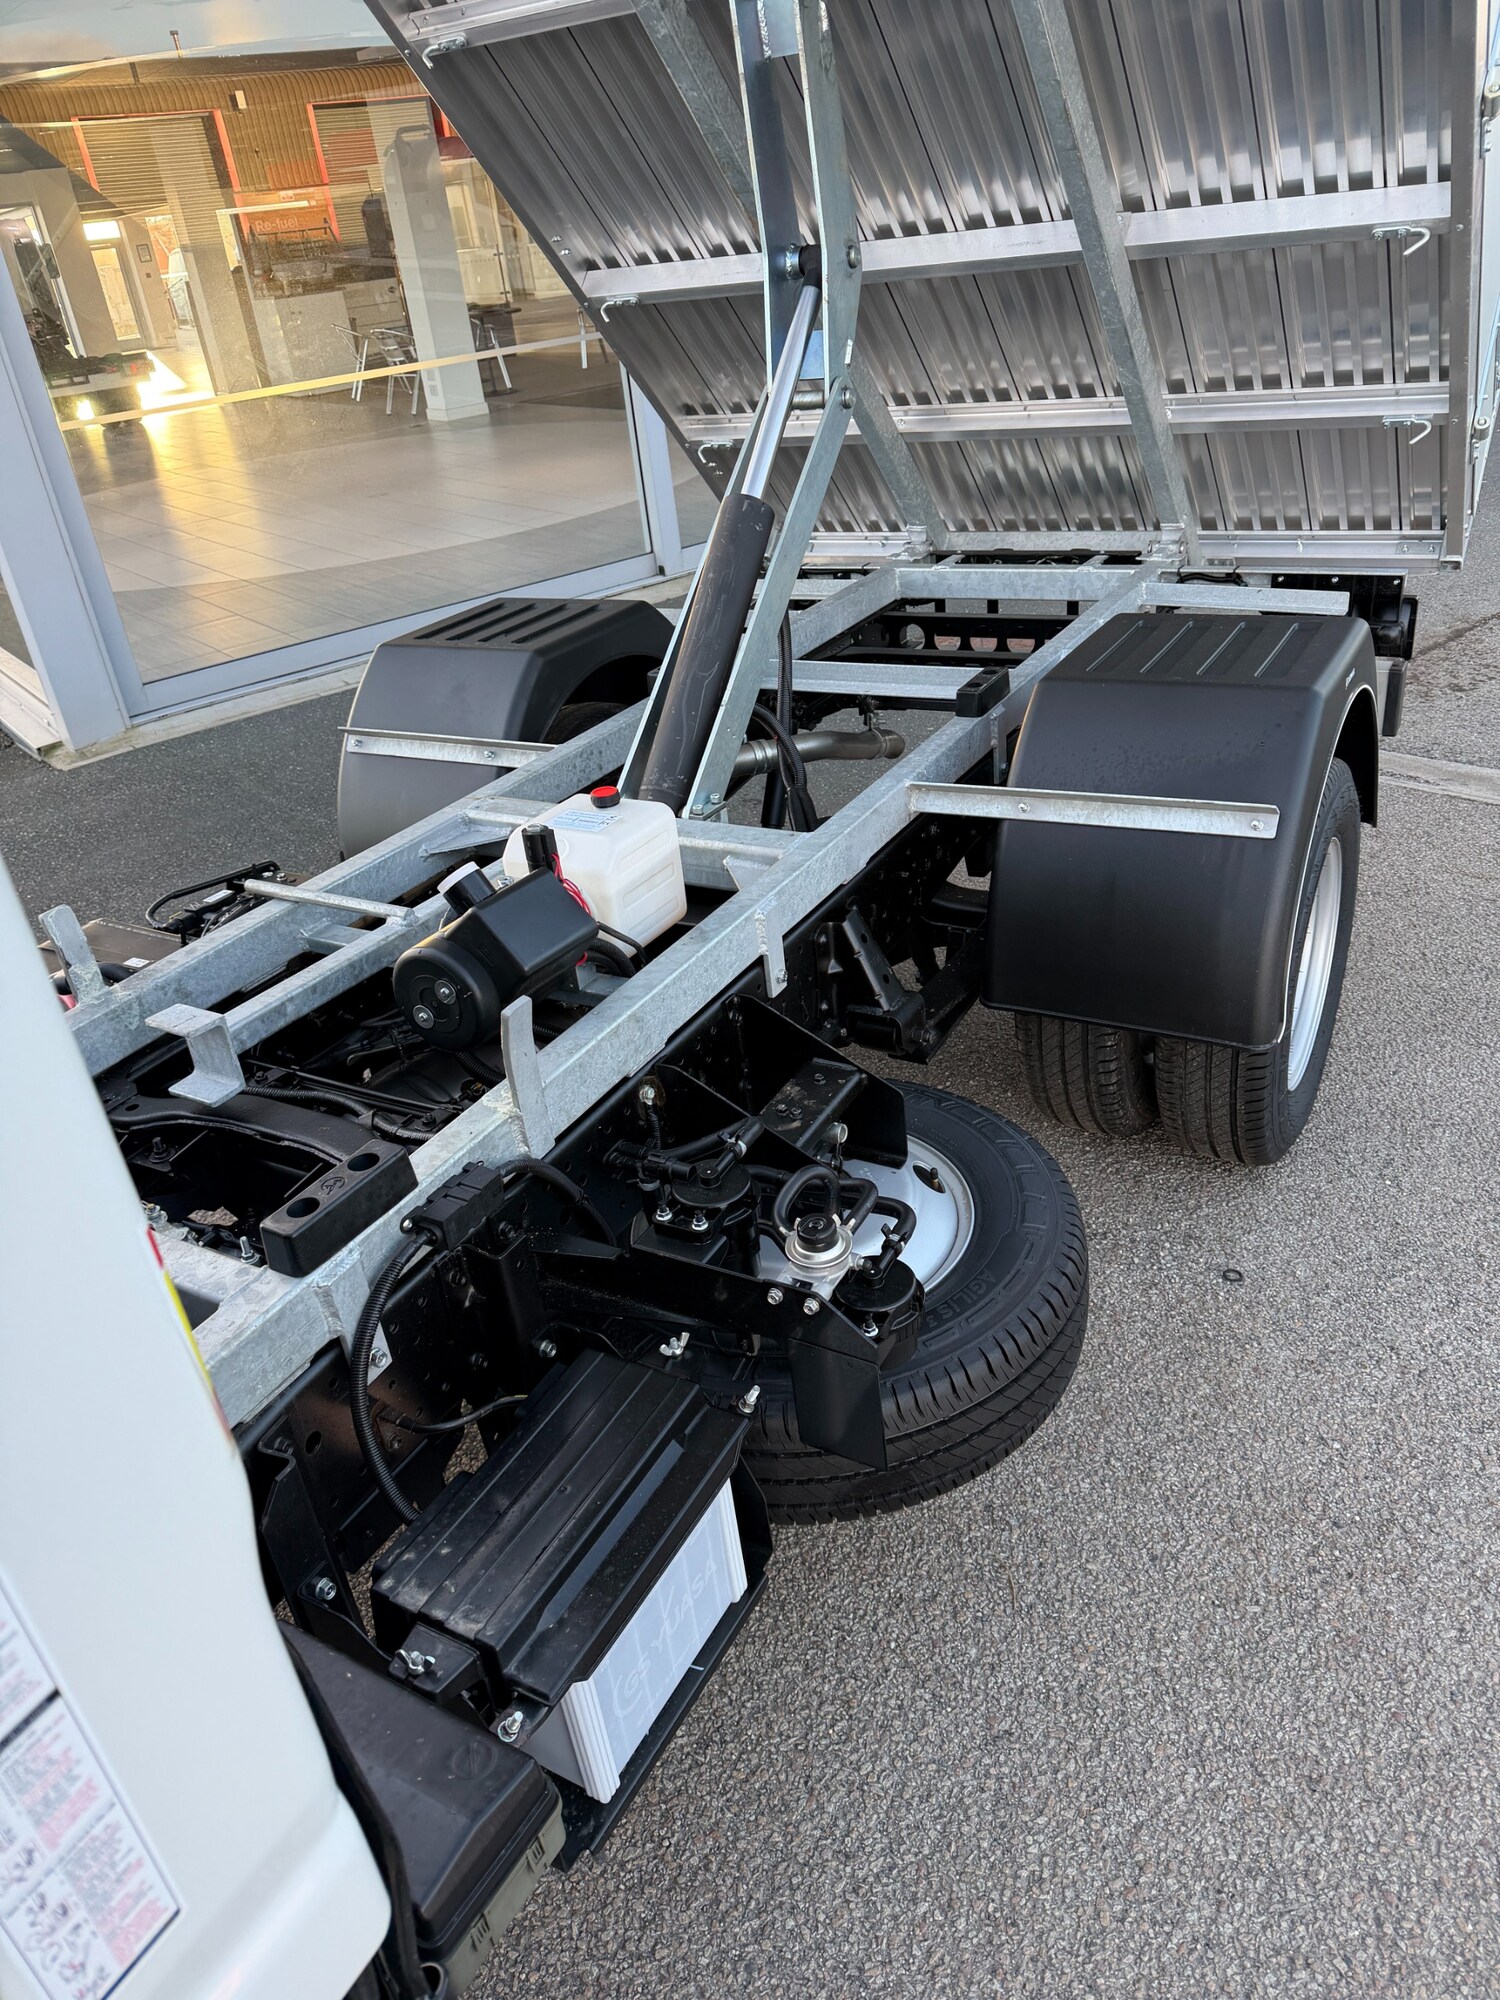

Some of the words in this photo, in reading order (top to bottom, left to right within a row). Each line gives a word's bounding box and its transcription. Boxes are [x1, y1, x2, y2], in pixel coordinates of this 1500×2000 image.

[255, 217, 298, 232] Re-fuel
[940, 1269, 996, 1319] AGILIS
[624, 1652, 652, 1699] GS
[650, 1558, 718, 1654] YUASA
